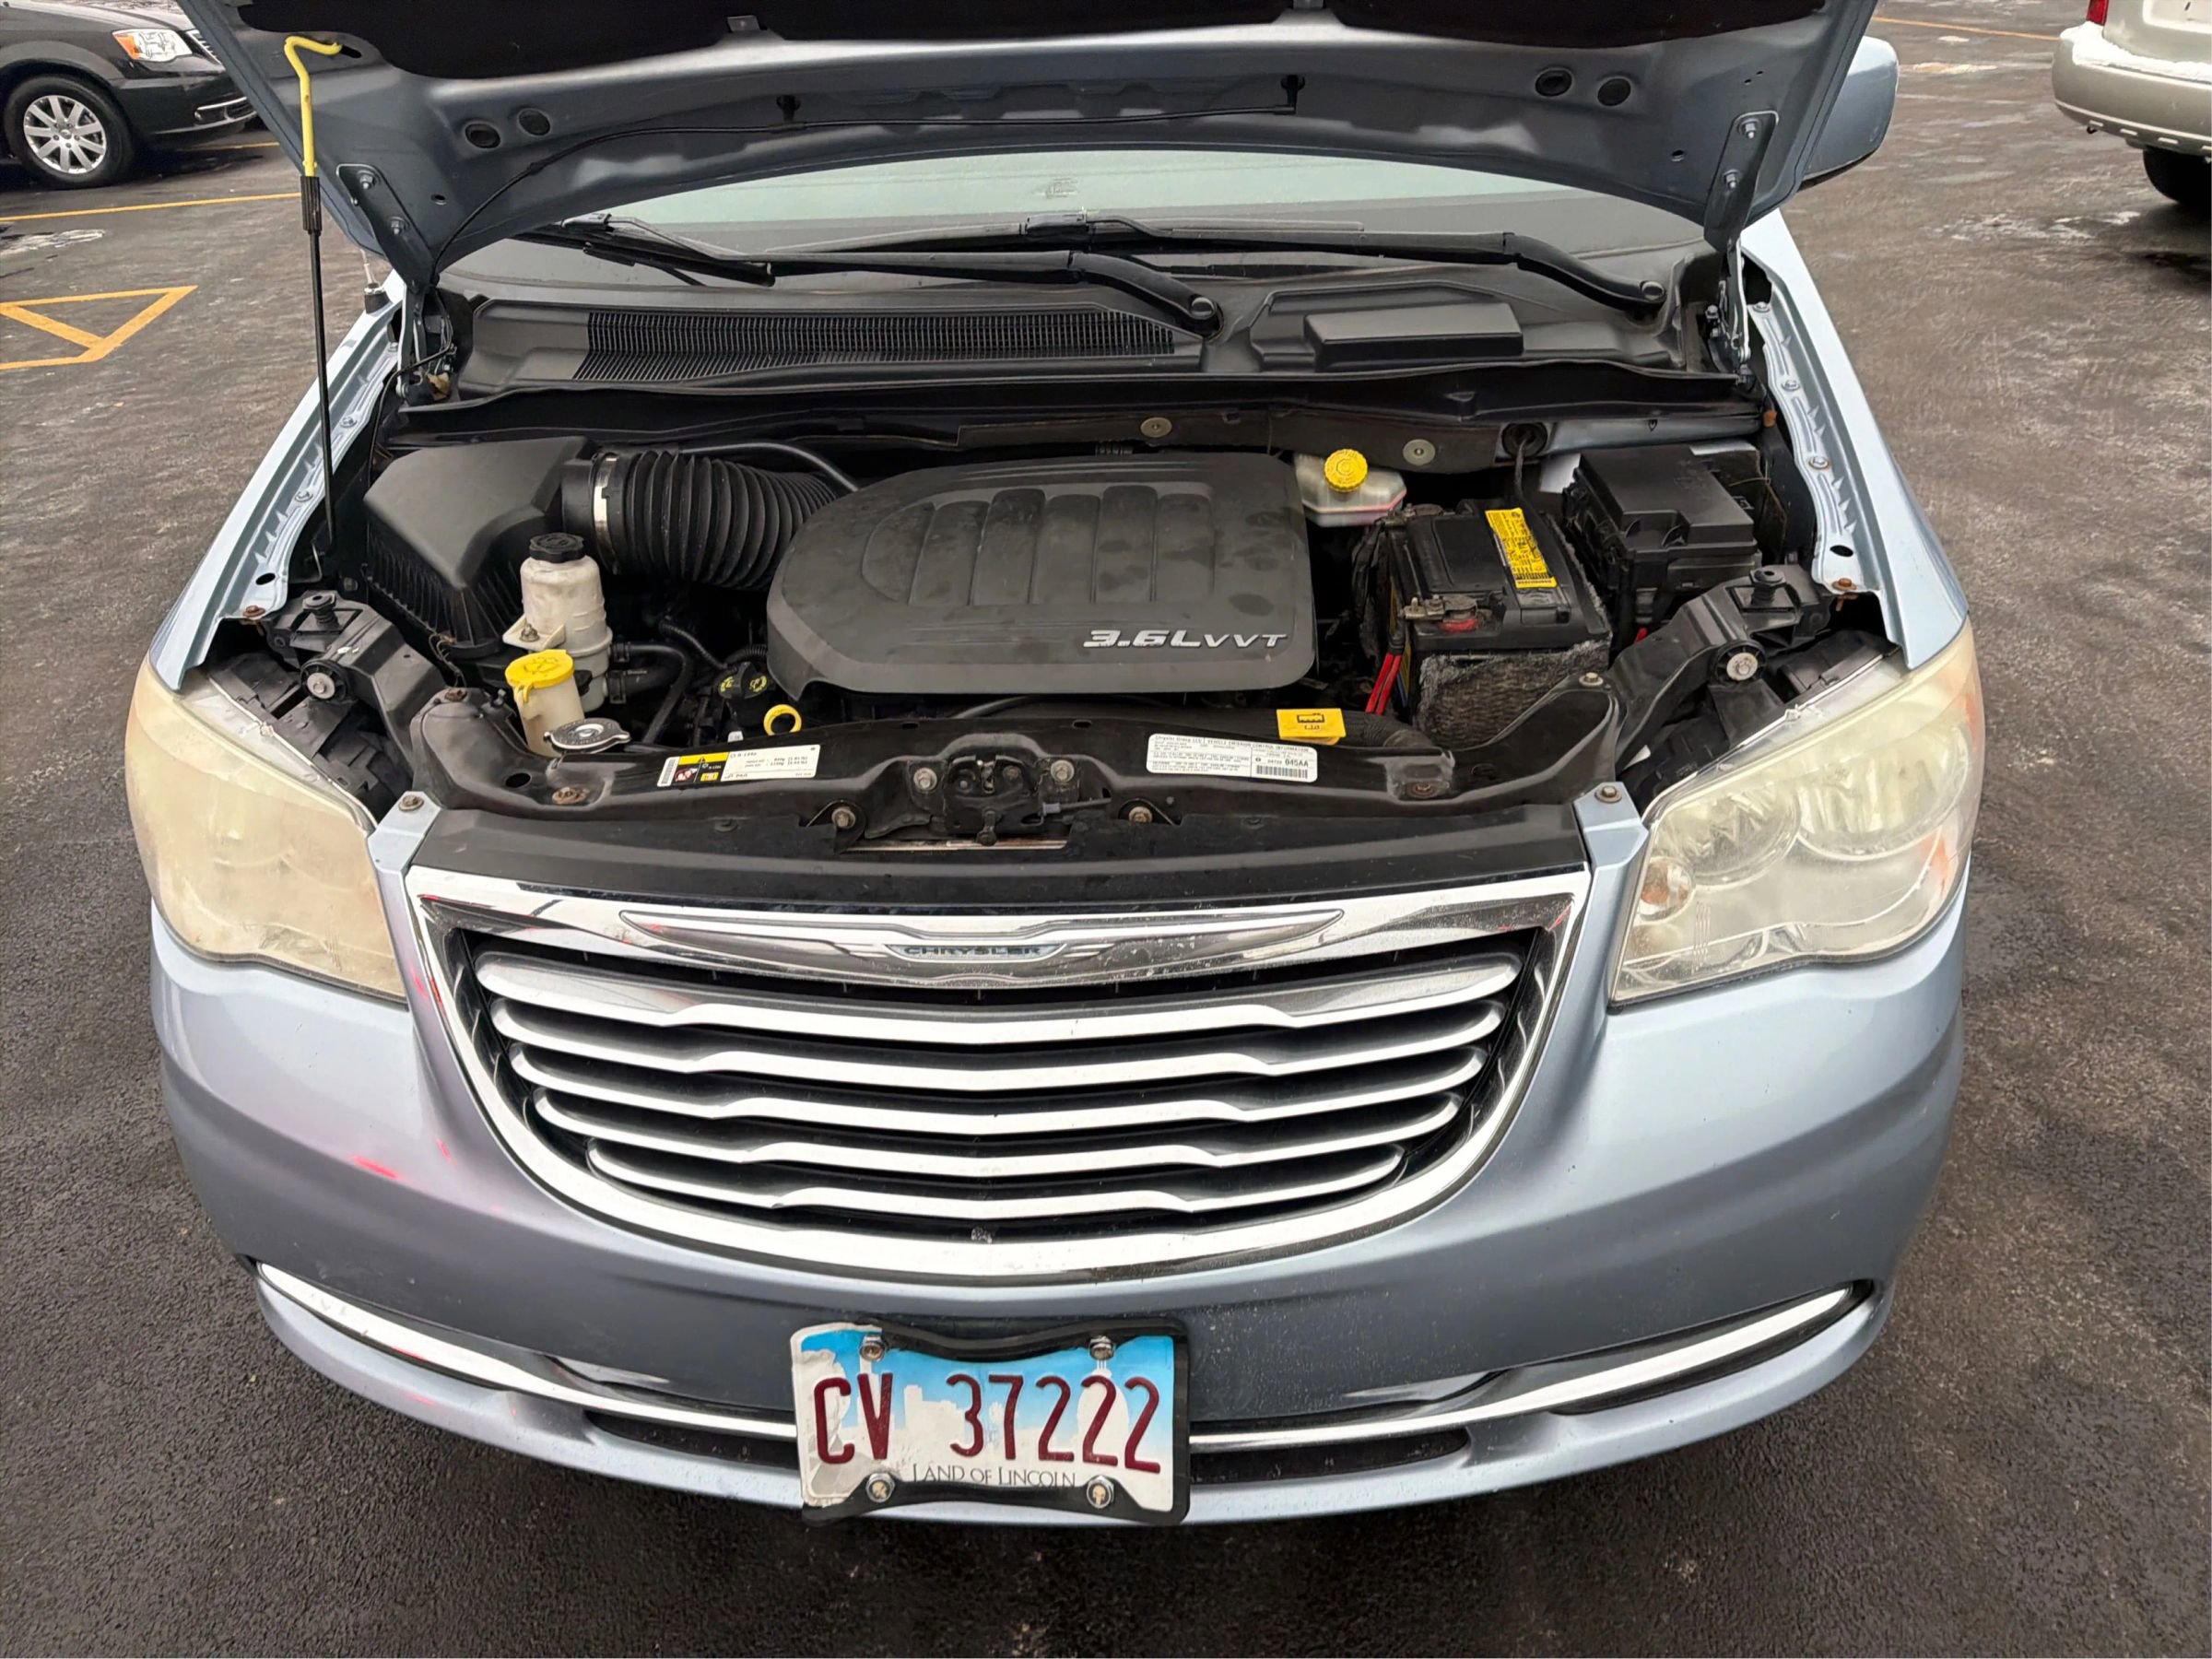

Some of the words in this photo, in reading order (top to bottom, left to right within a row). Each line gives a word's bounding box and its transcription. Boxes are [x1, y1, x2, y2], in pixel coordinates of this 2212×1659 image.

[903, 946, 1041, 956] CHRYSLER
[813, 1372, 894, 1465] CV
[945, 1372, 1161, 1475] 37222
[912, 1464, 965, 1483] LAND
[970, 1468, 992, 1484] OF
[998, 1466, 1076, 1488] LINCOLN
